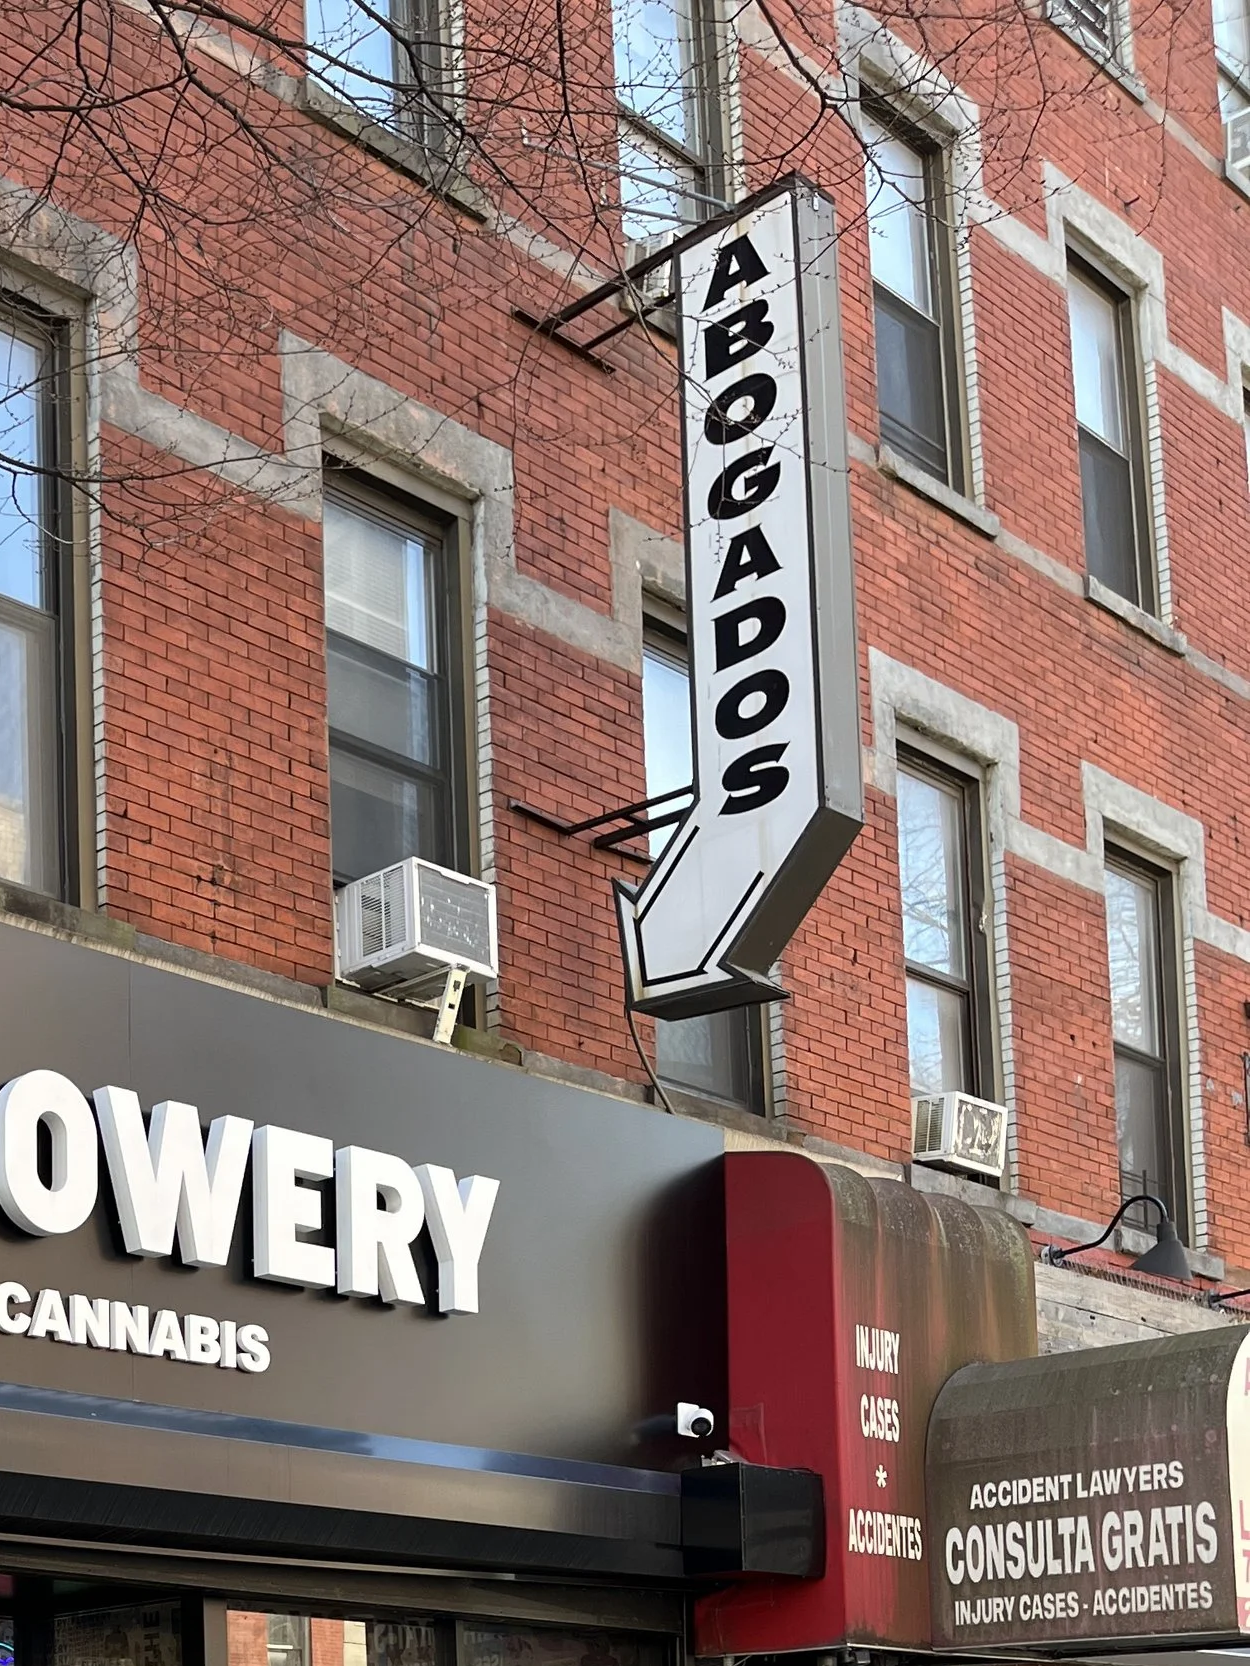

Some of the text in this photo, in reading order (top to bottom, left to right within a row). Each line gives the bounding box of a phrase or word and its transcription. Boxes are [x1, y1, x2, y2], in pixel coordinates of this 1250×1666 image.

[702, 233, 789, 818] ABOGADOS
[855, 1324, 900, 1374] INJURY
[860, 1394, 900, 1443] CASES
[970, 1461, 1184, 1510] ACCIDENT LAWYERS
[849, 1508, 922, 1561] ACCIDENTES
[945, 1515, 1095, 1585] CONSULTA
[1101, 1501, 1218, 1572] GRATIS
[955, 1597, 1015, 1626] INJURY
[1019, 1591, 1079, 1619] CASES
[1093, 1581, 1213, 1615] ACCIDENTES
